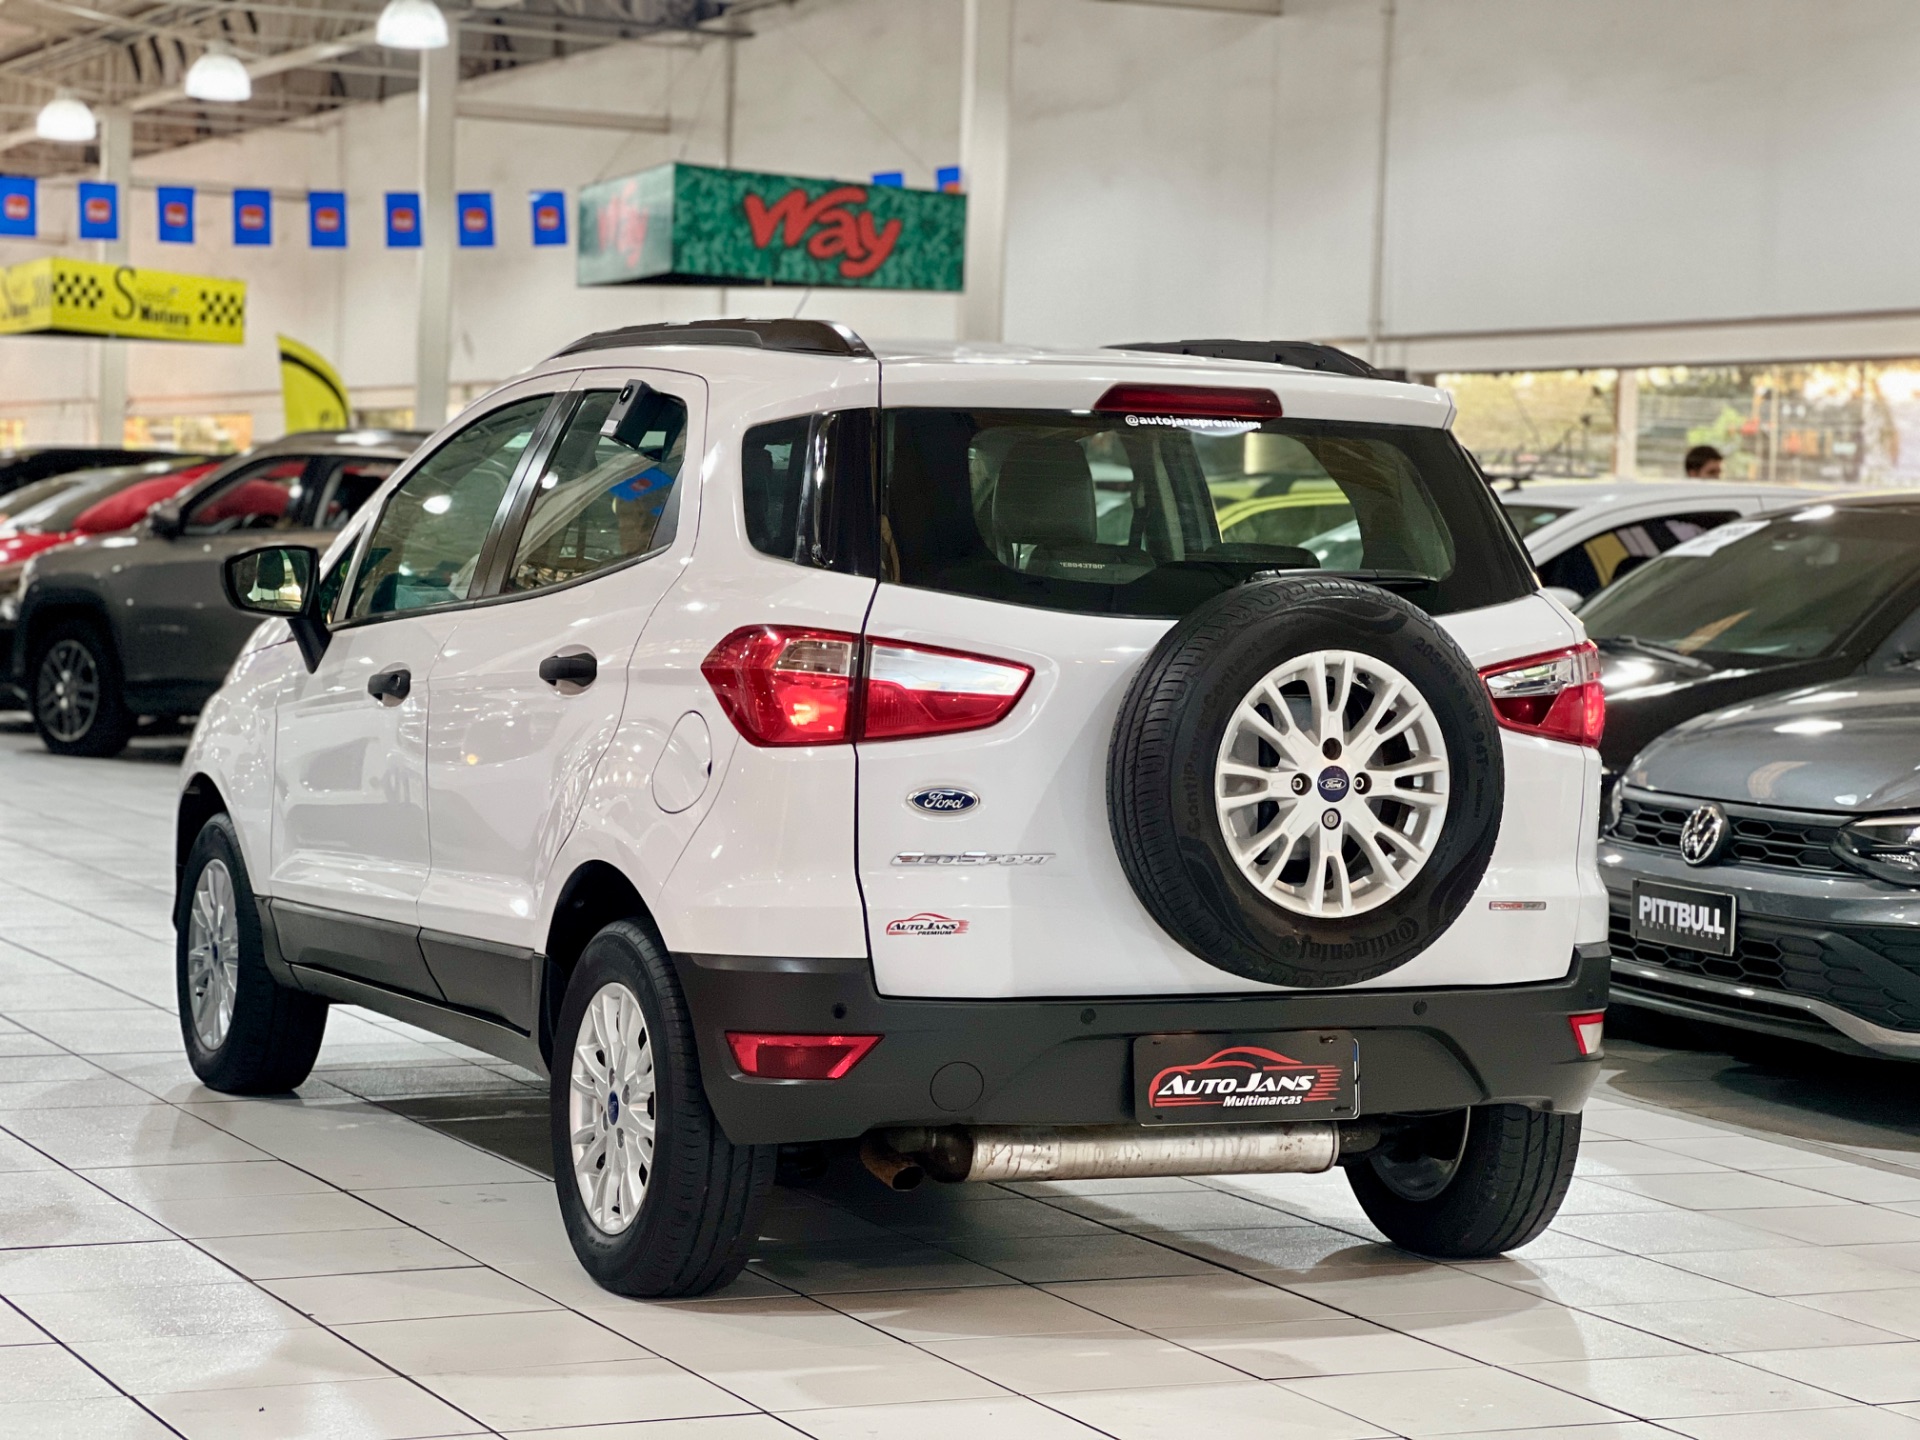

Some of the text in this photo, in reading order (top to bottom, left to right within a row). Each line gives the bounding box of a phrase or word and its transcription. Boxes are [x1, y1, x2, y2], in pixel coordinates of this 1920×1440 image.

[743, 186, 901, 278] Way
[924, 790, 964, 809] Ford
[1638, 895, 1725, 935] PITTBULL
[1641, 919, 1721, 941] MULTIMARCAS
[1299, 916, 1420, 961] Continental
[1223, 1094, 1302, 1107] Multimarcas
